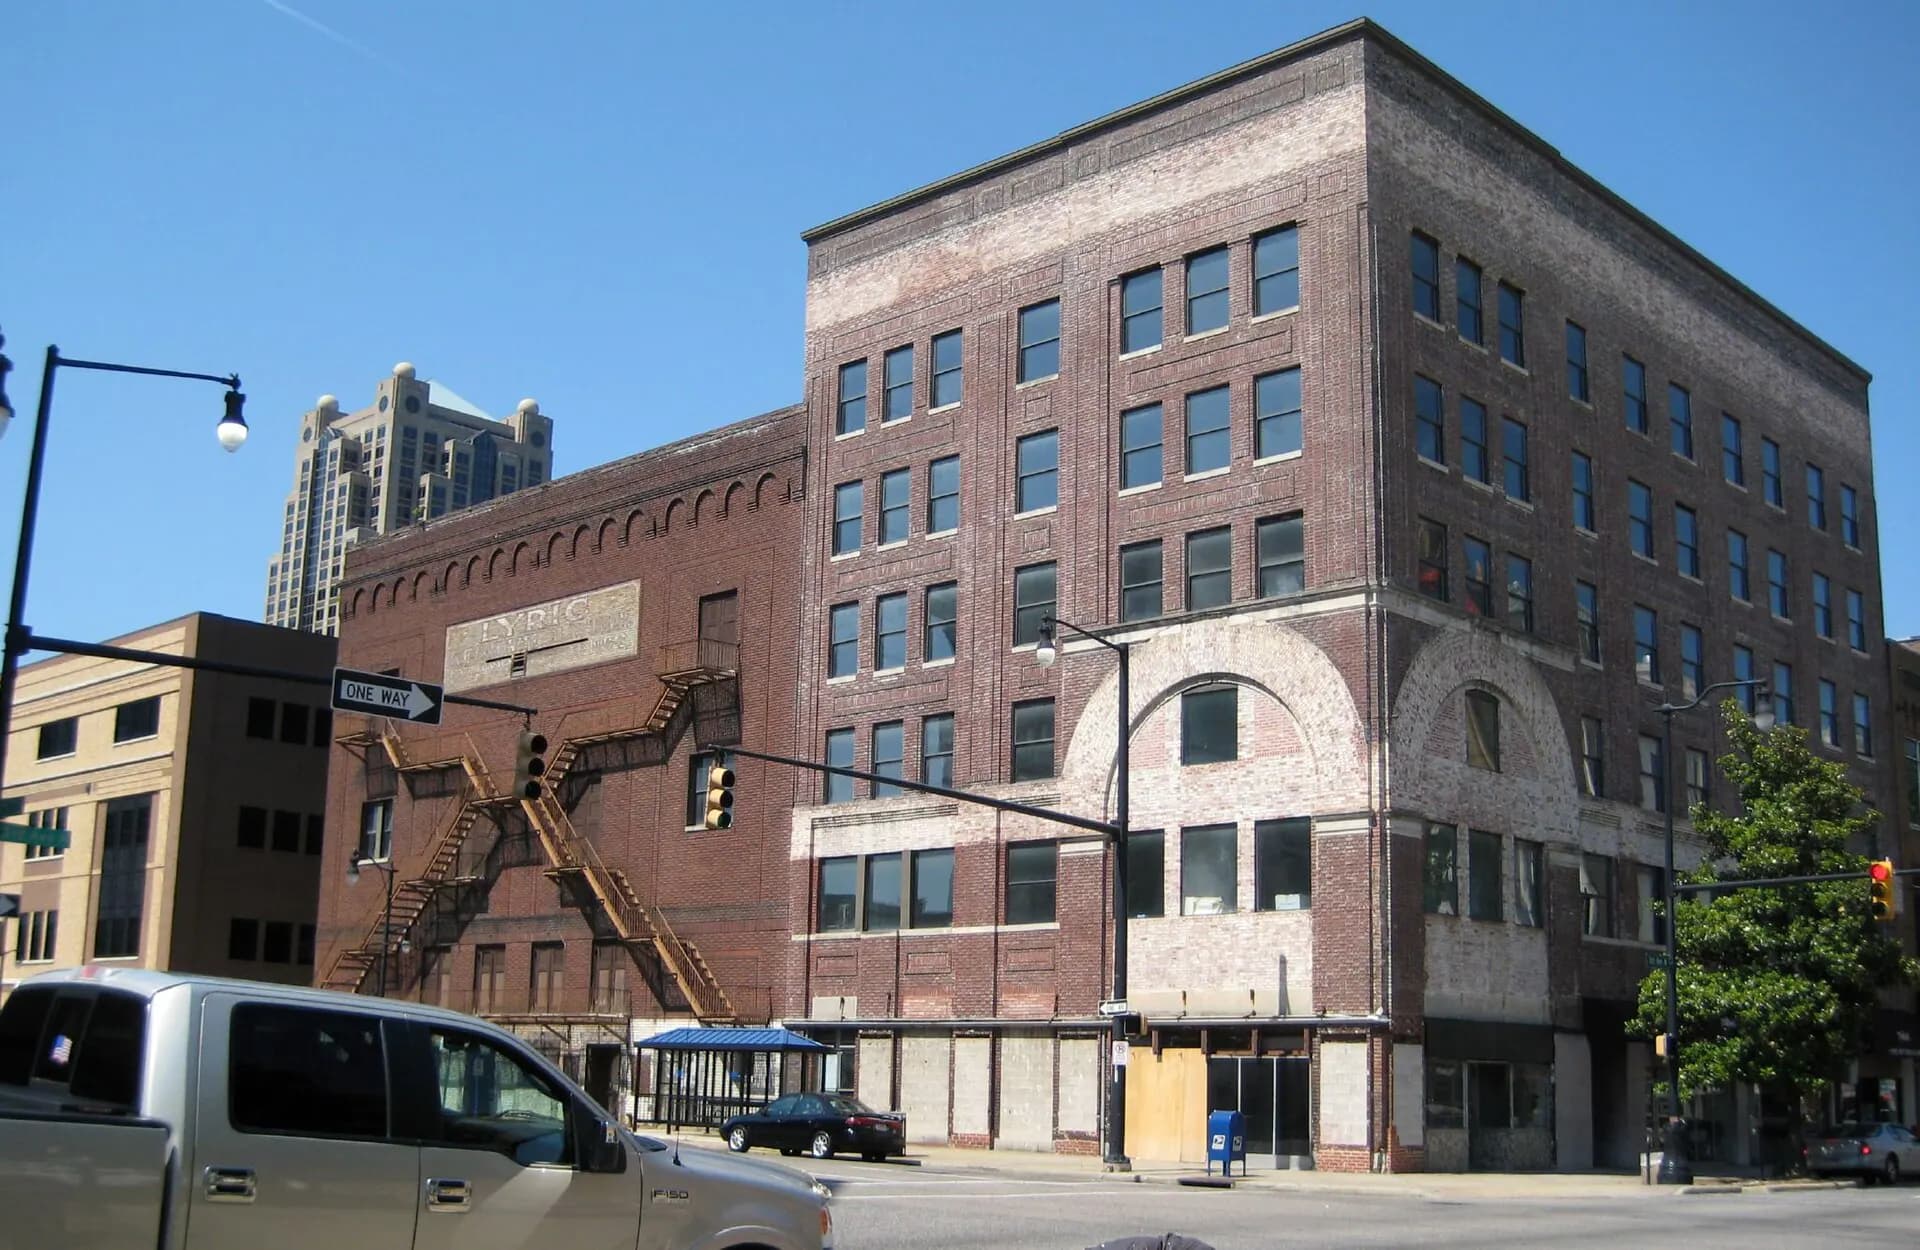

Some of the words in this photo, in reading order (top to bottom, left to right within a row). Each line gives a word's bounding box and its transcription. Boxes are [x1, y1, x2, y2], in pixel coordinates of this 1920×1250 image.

[480, 598, 589, 642] LYRIC
[346, 683, 373, 701] ONE
[381, 689, 410, 707] WAY
